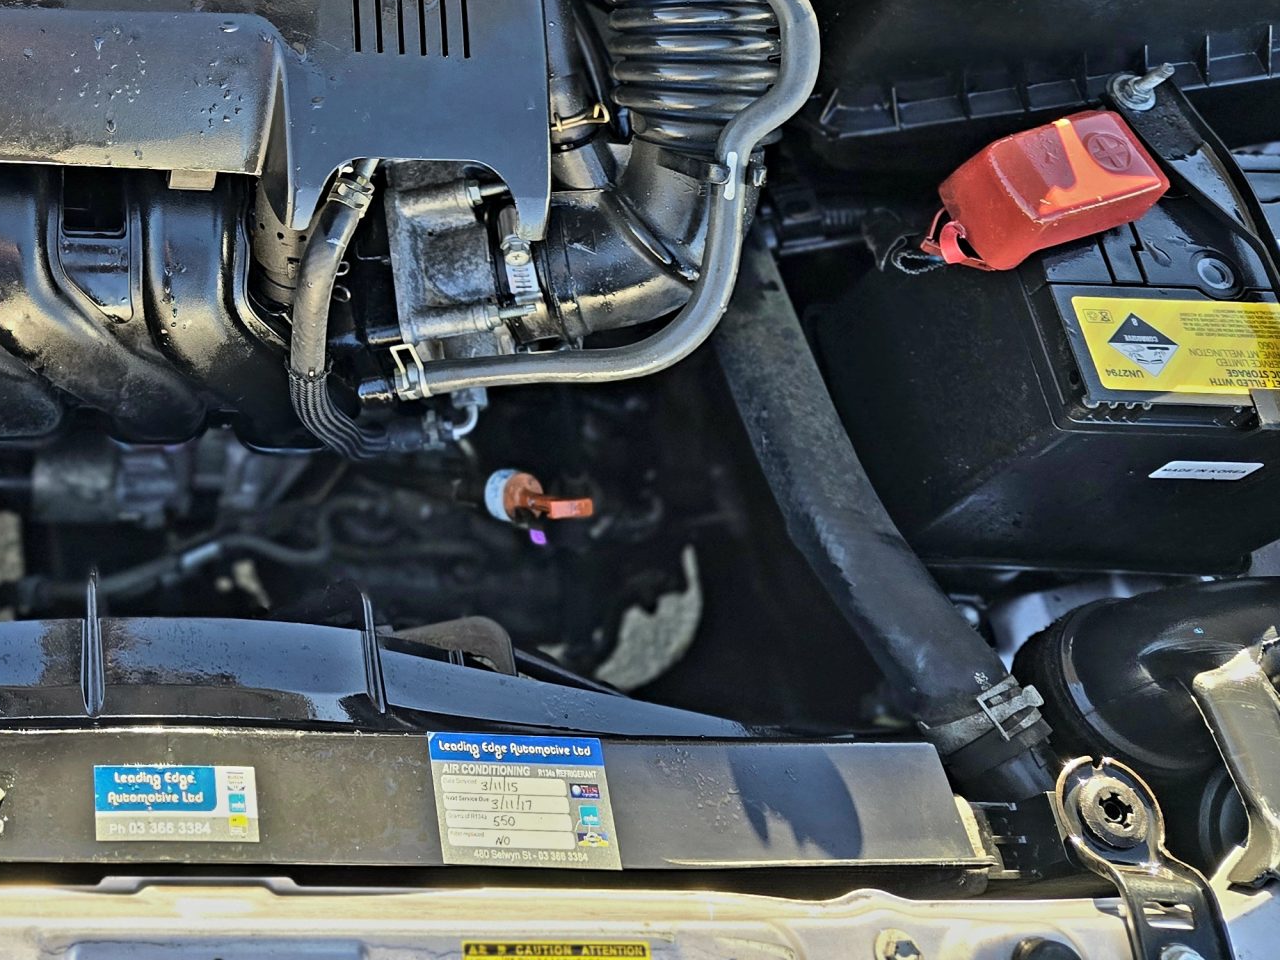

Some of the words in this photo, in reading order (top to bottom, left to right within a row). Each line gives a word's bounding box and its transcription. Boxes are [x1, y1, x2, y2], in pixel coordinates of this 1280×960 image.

[1189, 348, 1246, 358] WELLINGTON
[1216, 358, 1250, 367] LIMITED
[1105, 368, 1144, 379] UN2794
[1226, 369, 1269, 378] STORAGE
[1209, 377, 1235, 386] WITH
[1237, 378, 1266, 388] FILLED
[438, 740, 480, 759] Leading
[481, 742, 508, 759] Edge
[510, 744, 570, 758] Automotive
[572, 745, 591, 757] Ltd
[442, 763, 460, 775] AIR
[461, 764, 531, 777] CONDITIONING
[556, 769, 597, 779] REFRIGERANT
[114, 772, 161, 790] Leading
[164, 772, 195, 790] Edge
[481, 776, 518, 793] 3/11/15
[108, 792, 179, 806] Automotive
[182, 792, 204, 803] Ltd
[490, 794, 533, 810] 3/11/17
[493, 815, 516, 828] 550
[109, 823, 126, 834] Ph
[129, 823, 146, 834] 03
[149, 822, 174, 834] 366
[178, 822, 212, 834] 3384
[495, 835, 511, 846] NO
[491, 850, 521, 861] Selwyn
[522, 850, 532, 860] St
[515, 944, 571, 956] CAUTION
[581, 945, 644, 957] ATTENTION
